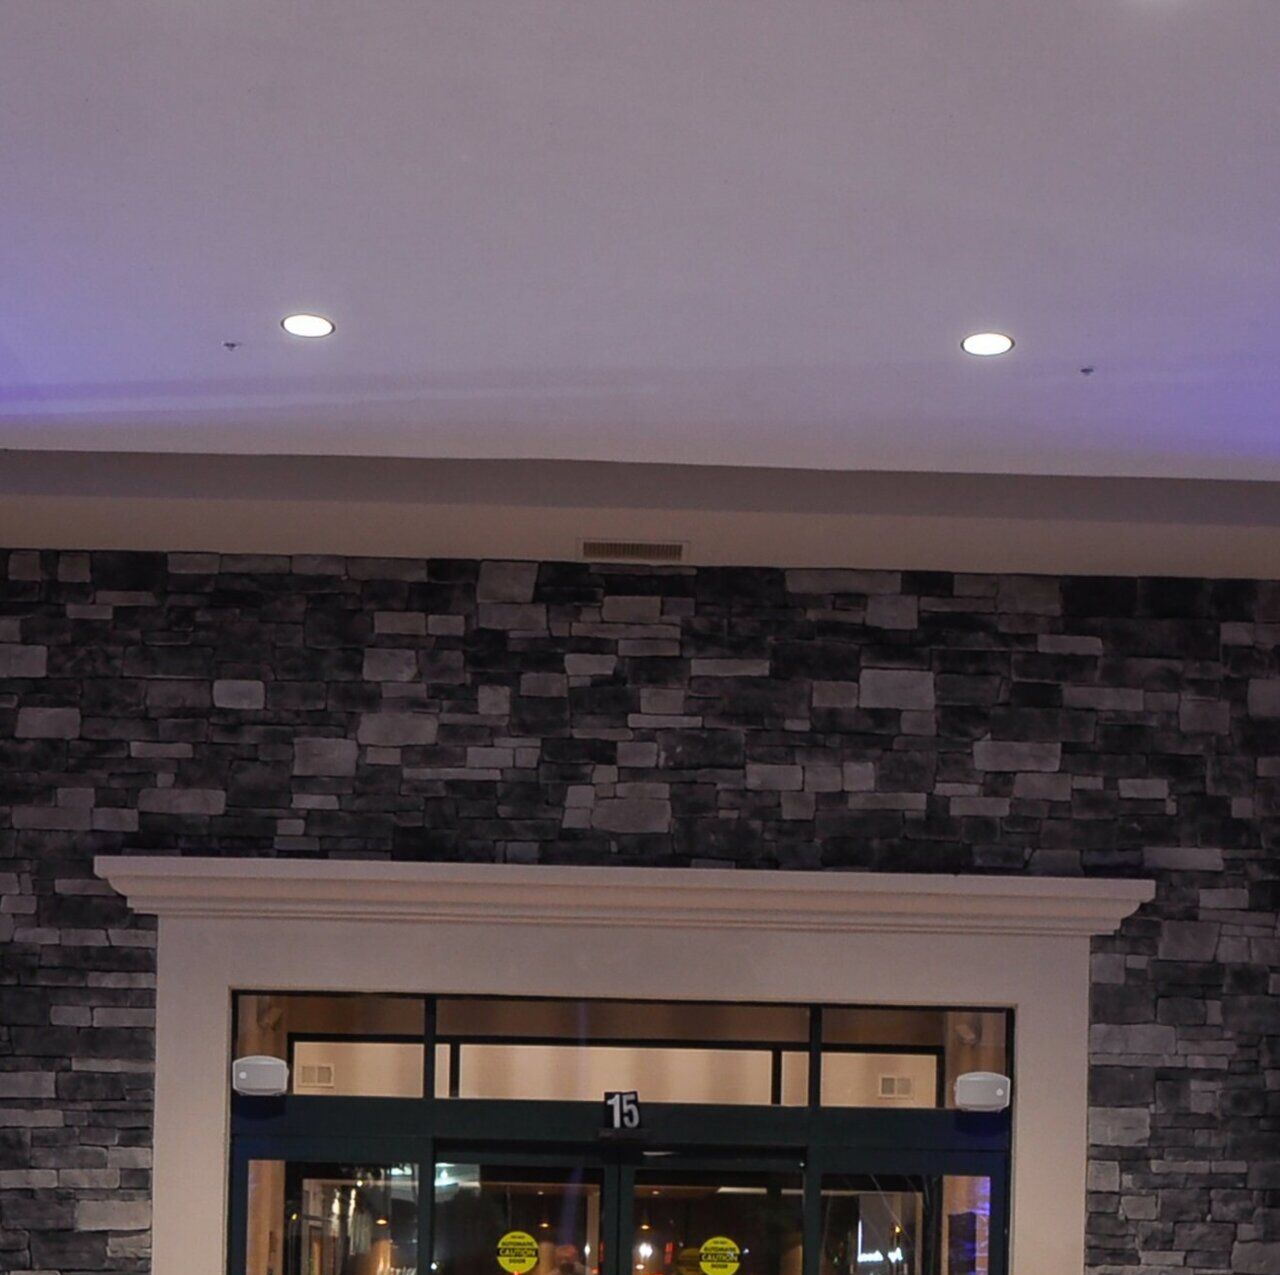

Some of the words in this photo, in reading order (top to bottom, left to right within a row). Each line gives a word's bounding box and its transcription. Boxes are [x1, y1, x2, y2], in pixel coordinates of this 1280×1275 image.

[606, 1094, 639, 1128] 15
[499, 1248, 536, 1257] CAUTION
[701, 1253, 738, 1262] CAUTION
